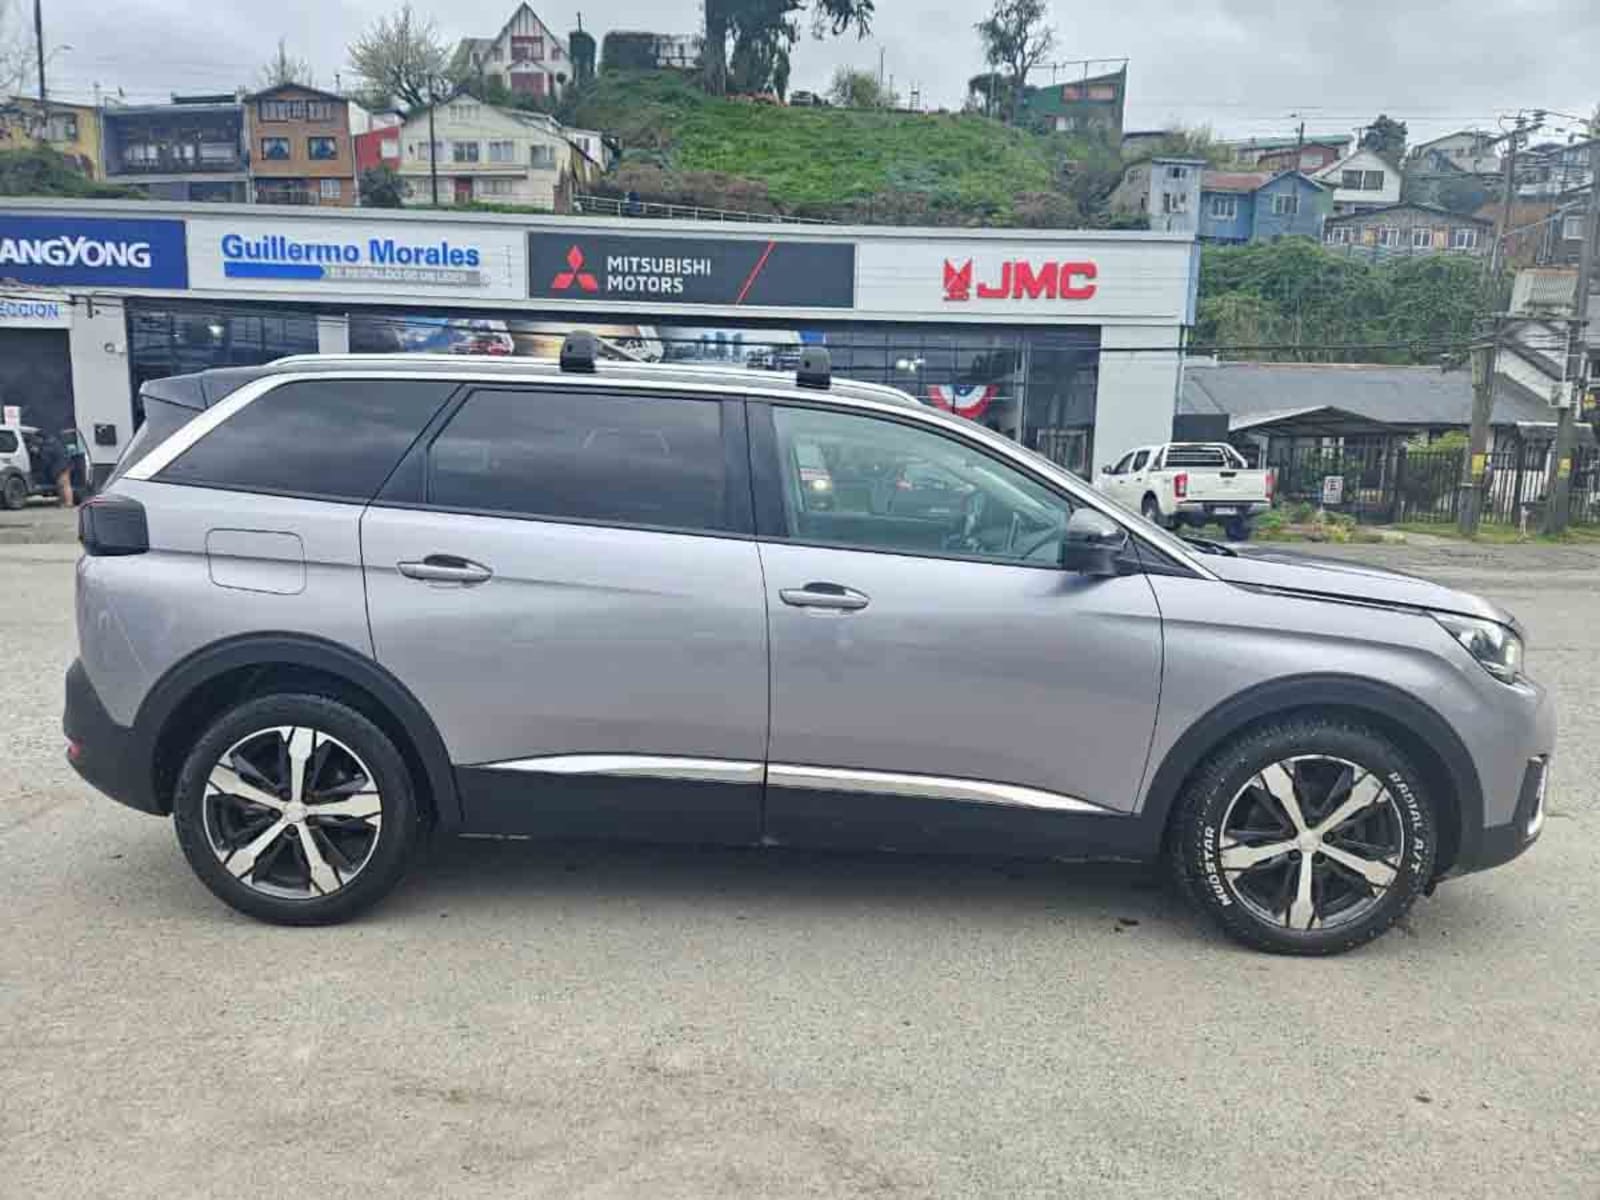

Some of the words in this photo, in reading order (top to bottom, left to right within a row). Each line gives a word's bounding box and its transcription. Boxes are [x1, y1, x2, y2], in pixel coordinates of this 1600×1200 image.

[0, 235, 151, 268] ANGYONG
[222, 234, 359, 262] Guillermo
[368, 239, 480, 267] Morales
[607, 256, 711, 275] MITSUBISHI
[607, 275, 684, 293] MOTORS
[977, 262, 1097, 299] JMC
[1204, 826, 1232, 906] MUDSTAR
